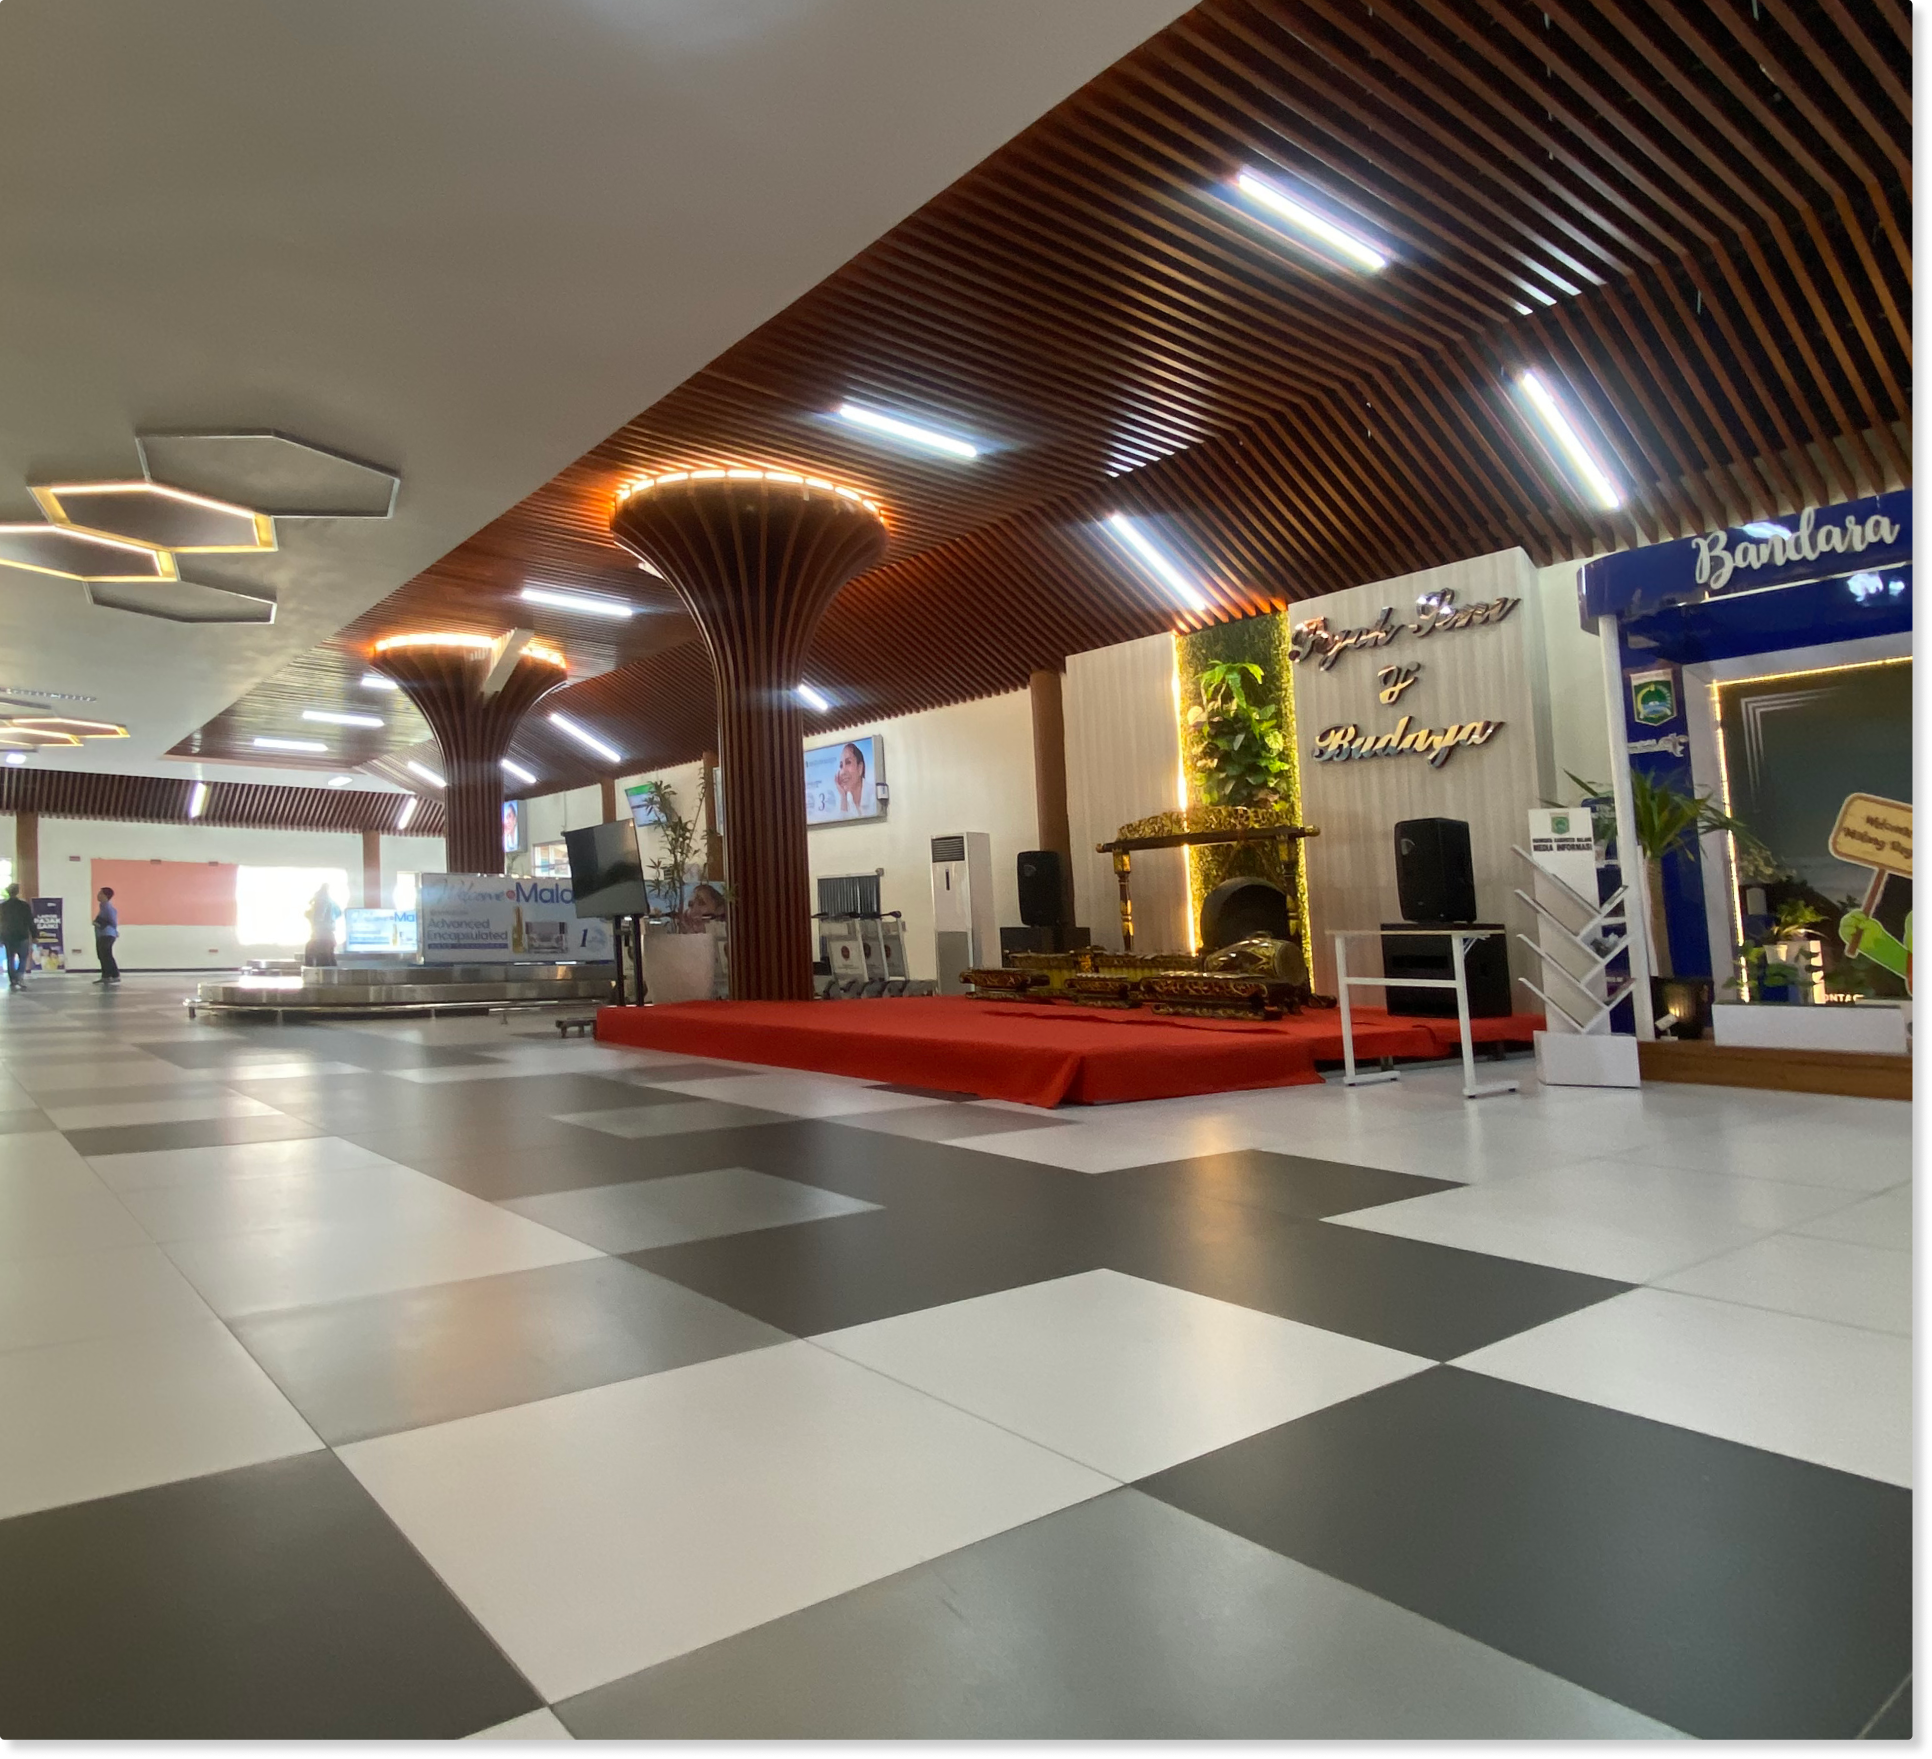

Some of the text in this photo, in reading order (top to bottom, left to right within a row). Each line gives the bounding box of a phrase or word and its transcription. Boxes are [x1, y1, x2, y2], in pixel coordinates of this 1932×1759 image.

[1691, 507, 1900, 589] Bandara
[1313, 715, 1506, 768] Budaya
[1556, 843, 1592, 851] INFORMASI
[427, 930, 508, 942] Encapsulated
